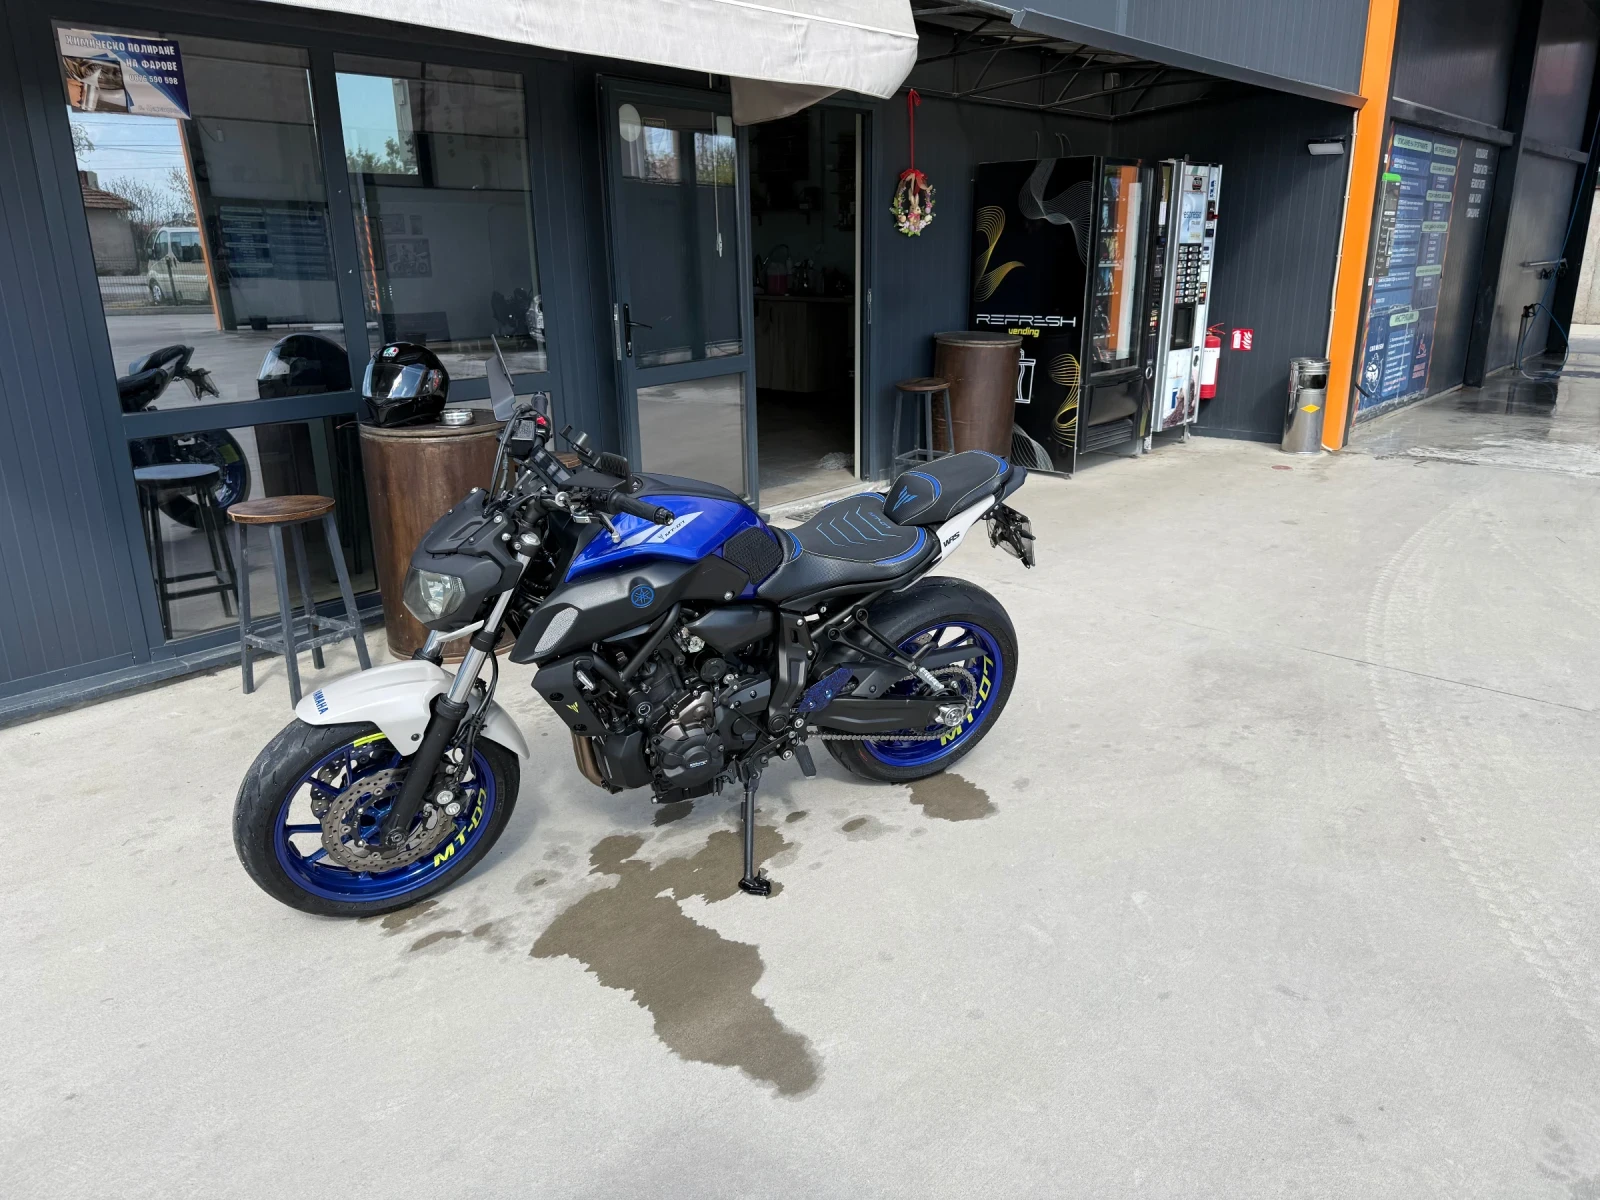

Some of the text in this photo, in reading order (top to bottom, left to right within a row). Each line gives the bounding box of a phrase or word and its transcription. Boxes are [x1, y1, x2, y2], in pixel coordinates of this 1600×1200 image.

[65, 35, 175, 55] ХИМИЧЕСКО ПОЛИРАНЕ
[126, 58, 178, 71] НА ФАРОВЕ
[149, 75, 163, 84] 590
[976, 313, 1077, 328] REFRESH
[1008, 326, 1040, 338] vending
[943, 531, 961, 548] WRS
[312, 689, 329, 715] YAMAHA
[433, 787, 487, 868] MT-07
